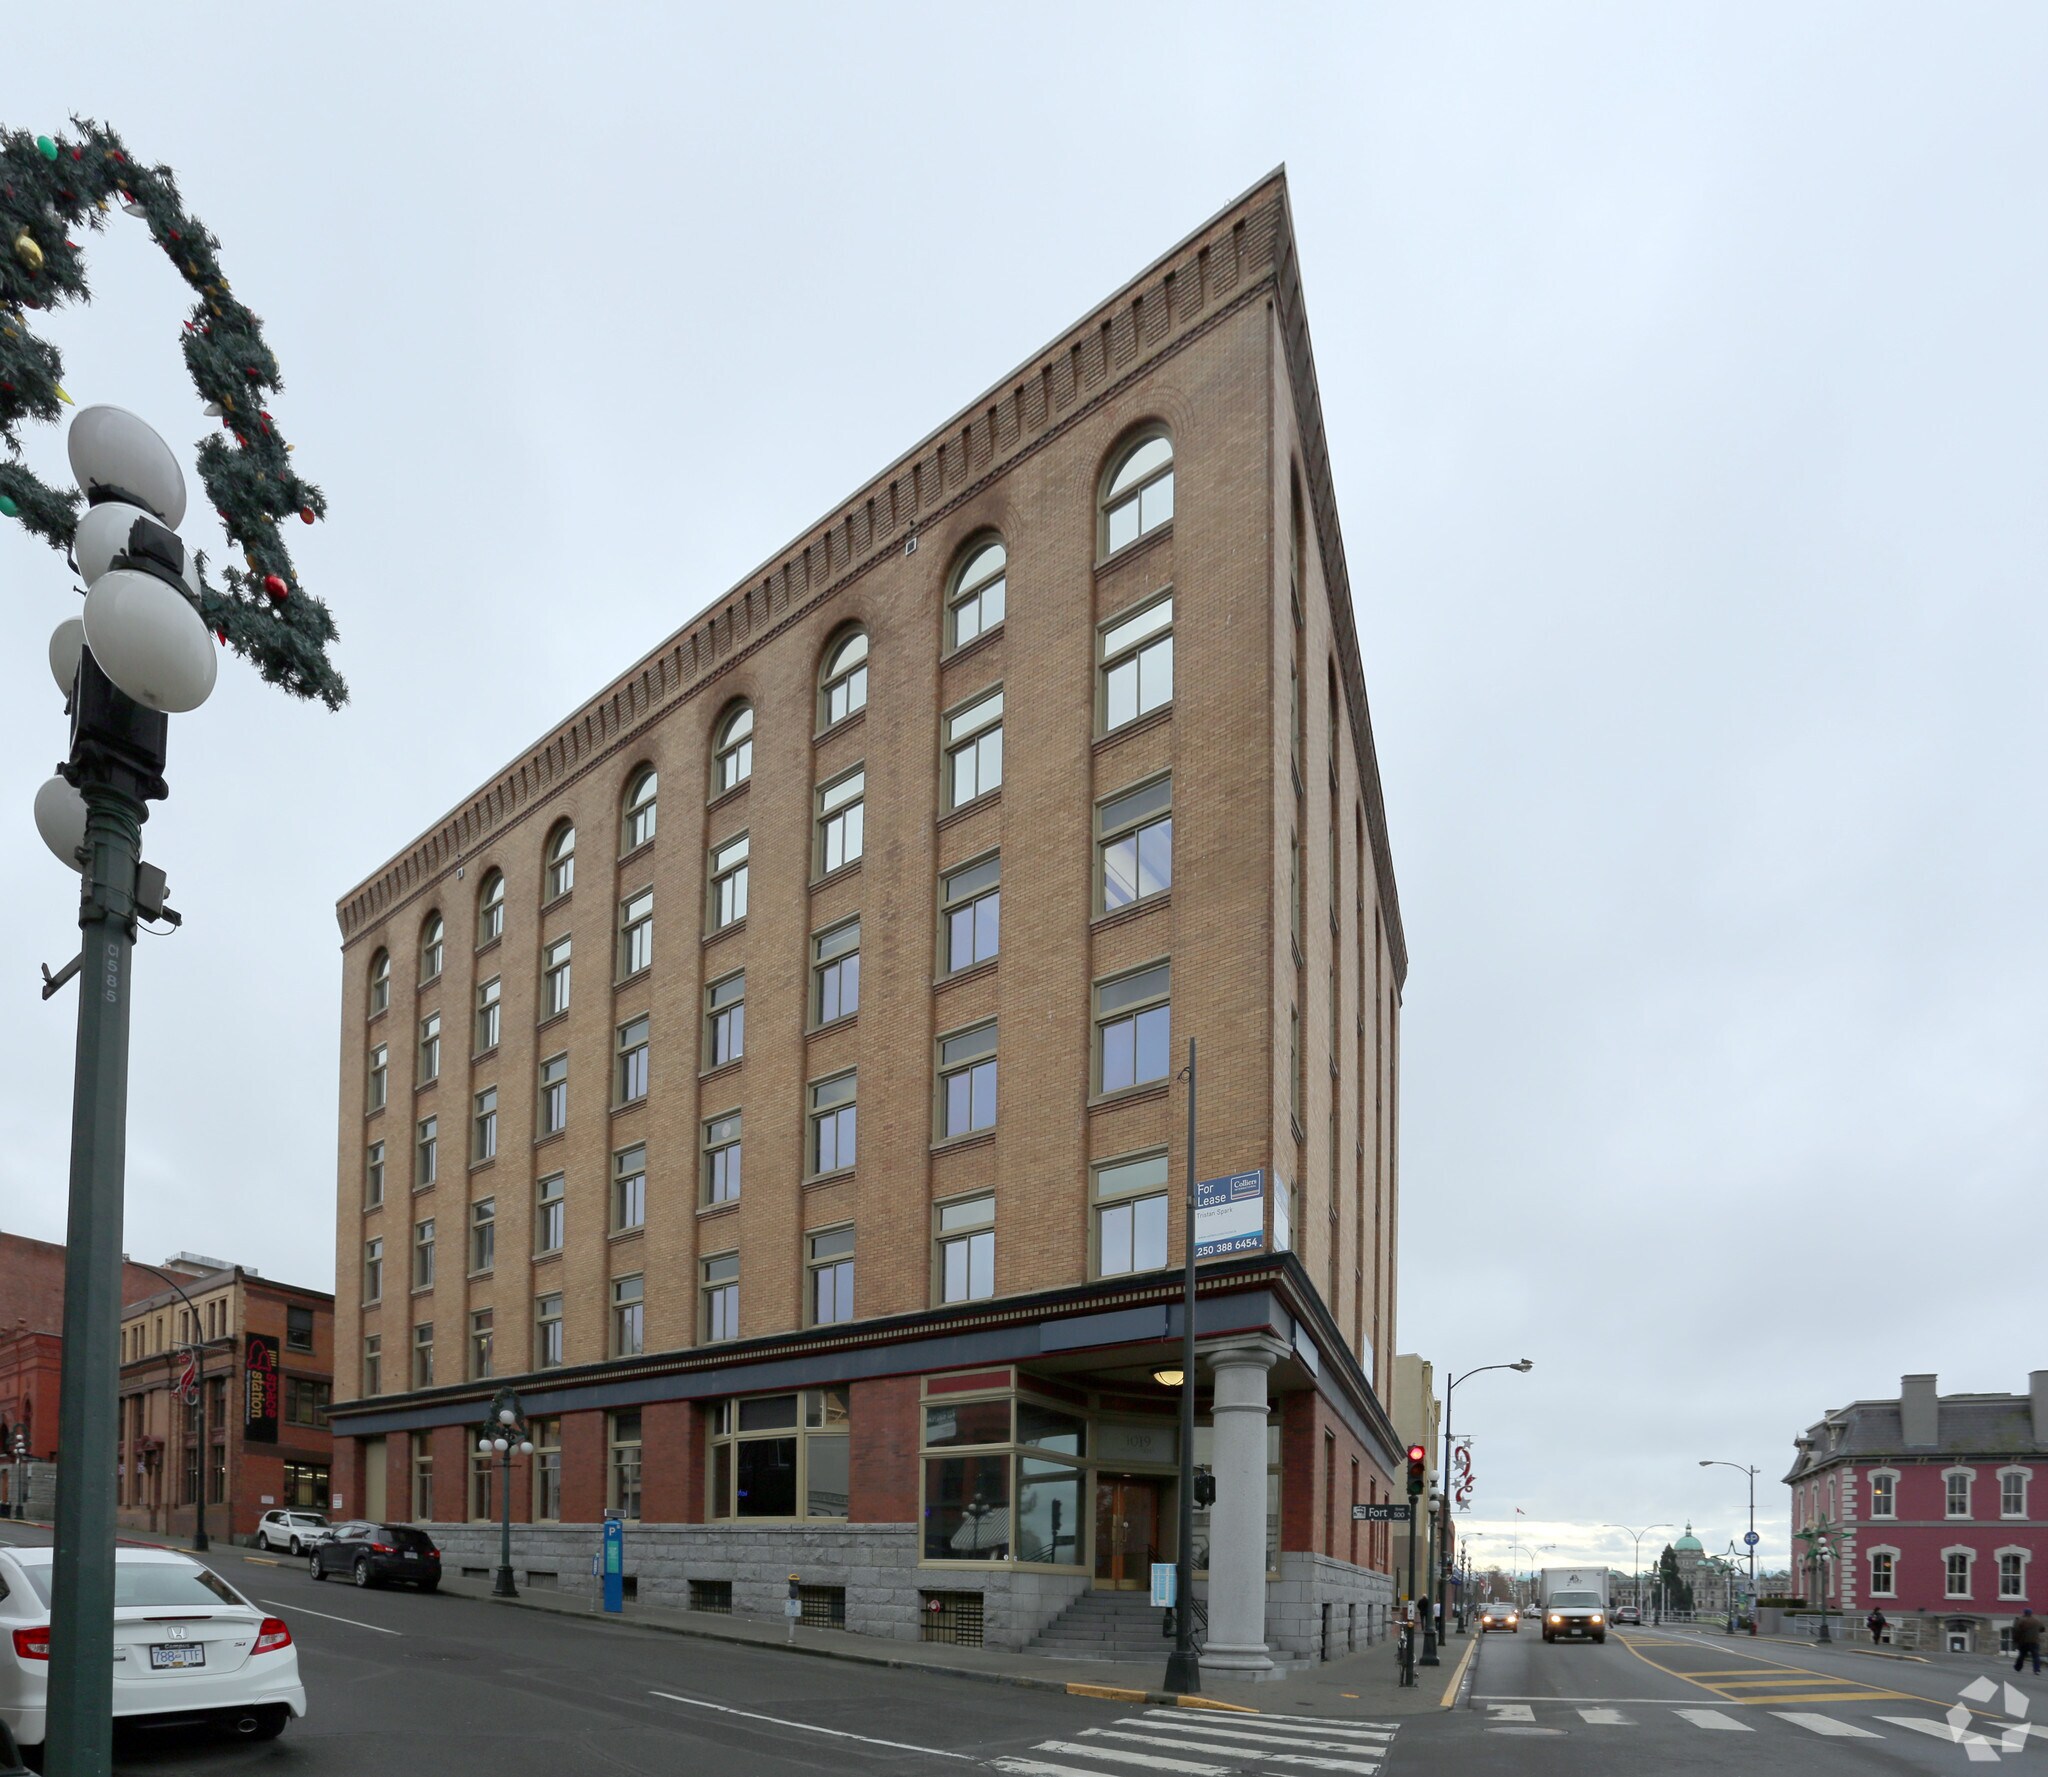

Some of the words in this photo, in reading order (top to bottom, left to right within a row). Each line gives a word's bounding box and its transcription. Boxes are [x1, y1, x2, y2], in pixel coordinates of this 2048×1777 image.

[1197, 1184, 1214, 1195] For
[1234, 1179, 1257, 1188] Colliers
[1197, 1194, 1227, 1207] Lease
[1197, 1246, 1214, 1256] 250
[1216, 1242, 1233, 1252] 388
[1235, 1238, 1257, 1249] 6454
[251, 1371, 265, 1418] station
[264, 1373, 277, 1418] space
[1369, 1507, 1387, 1517] Fort
[609, 1527, 616, 1536] P
[153, 1651, 175, 1663] 788
[182, 1650, 200, 1661] TTF
